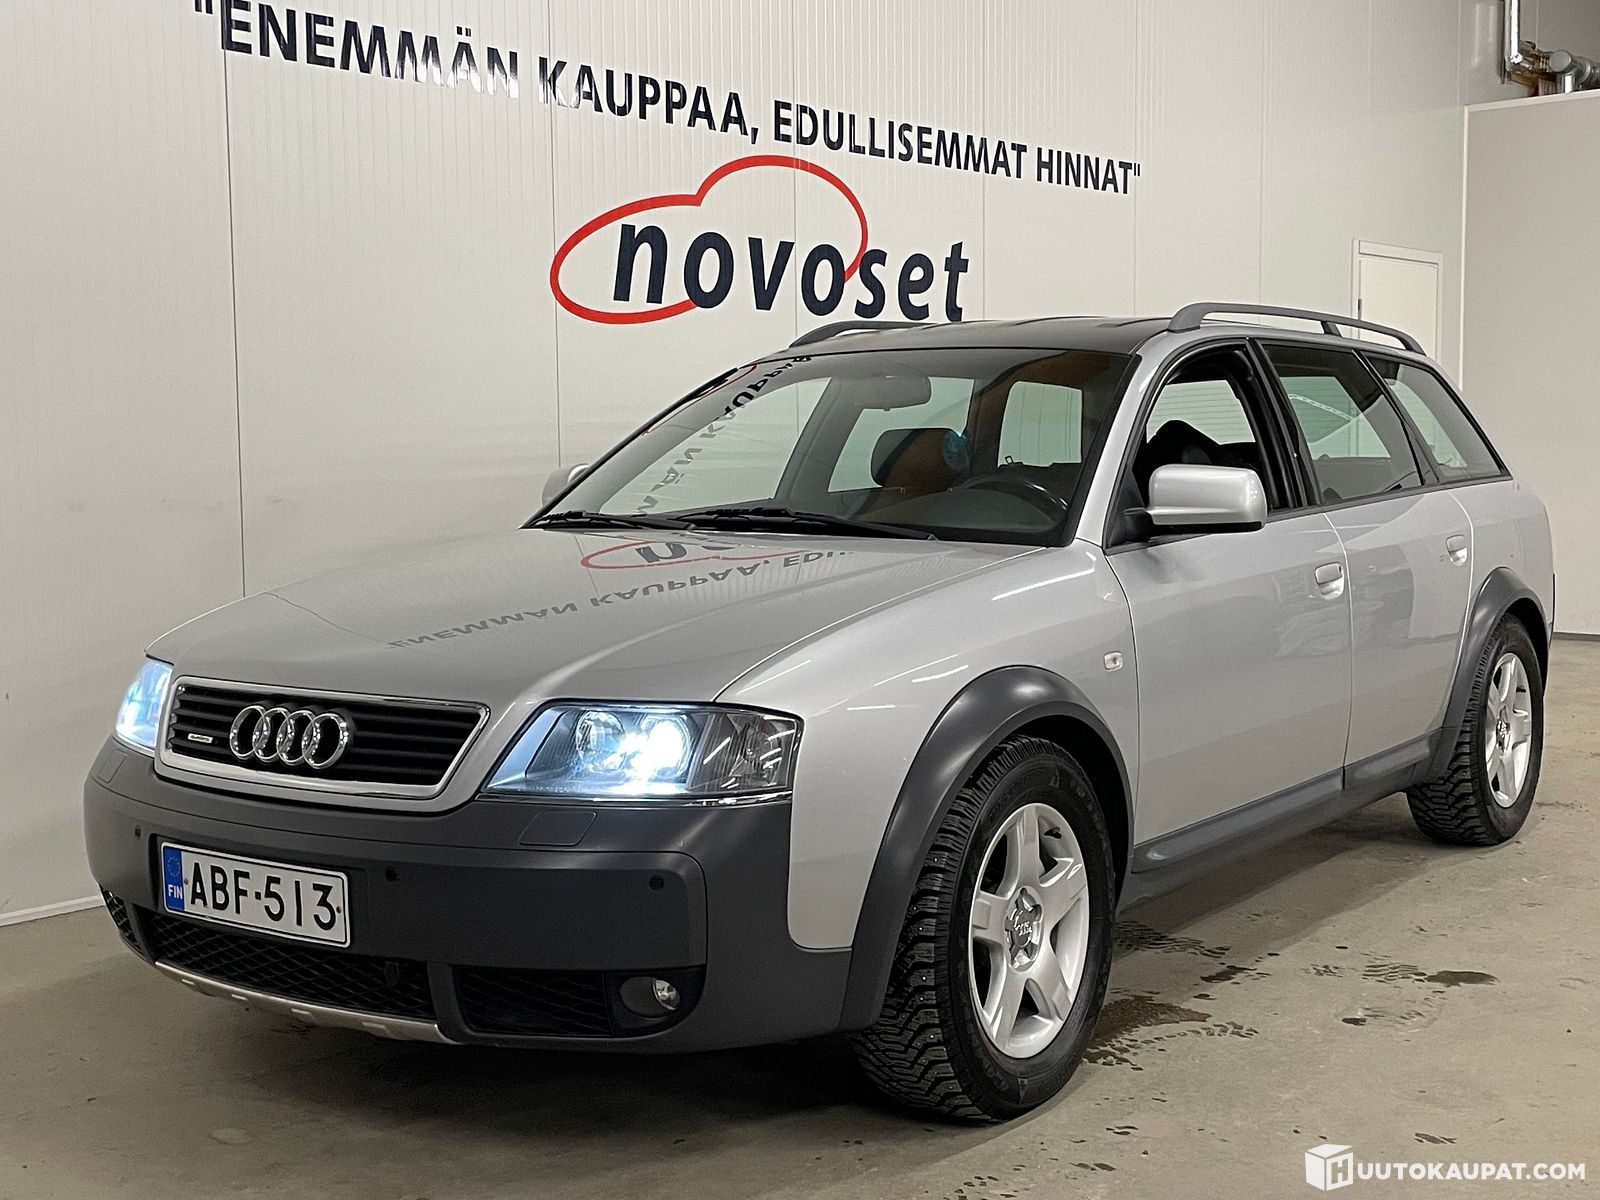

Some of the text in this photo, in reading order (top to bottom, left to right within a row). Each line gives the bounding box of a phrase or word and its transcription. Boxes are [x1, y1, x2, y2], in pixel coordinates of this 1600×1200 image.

[538, 56, 759, 145] KAUPPAA,
[773, 99, 1028, 179] EDULLISEMMAT
[1036, 147, 1141, 195] HINNAT"
[613, 223, 970, 323] novoset
[167, 884, 184, 900] FIN
[190, 862, 337, 931] ABF-513
